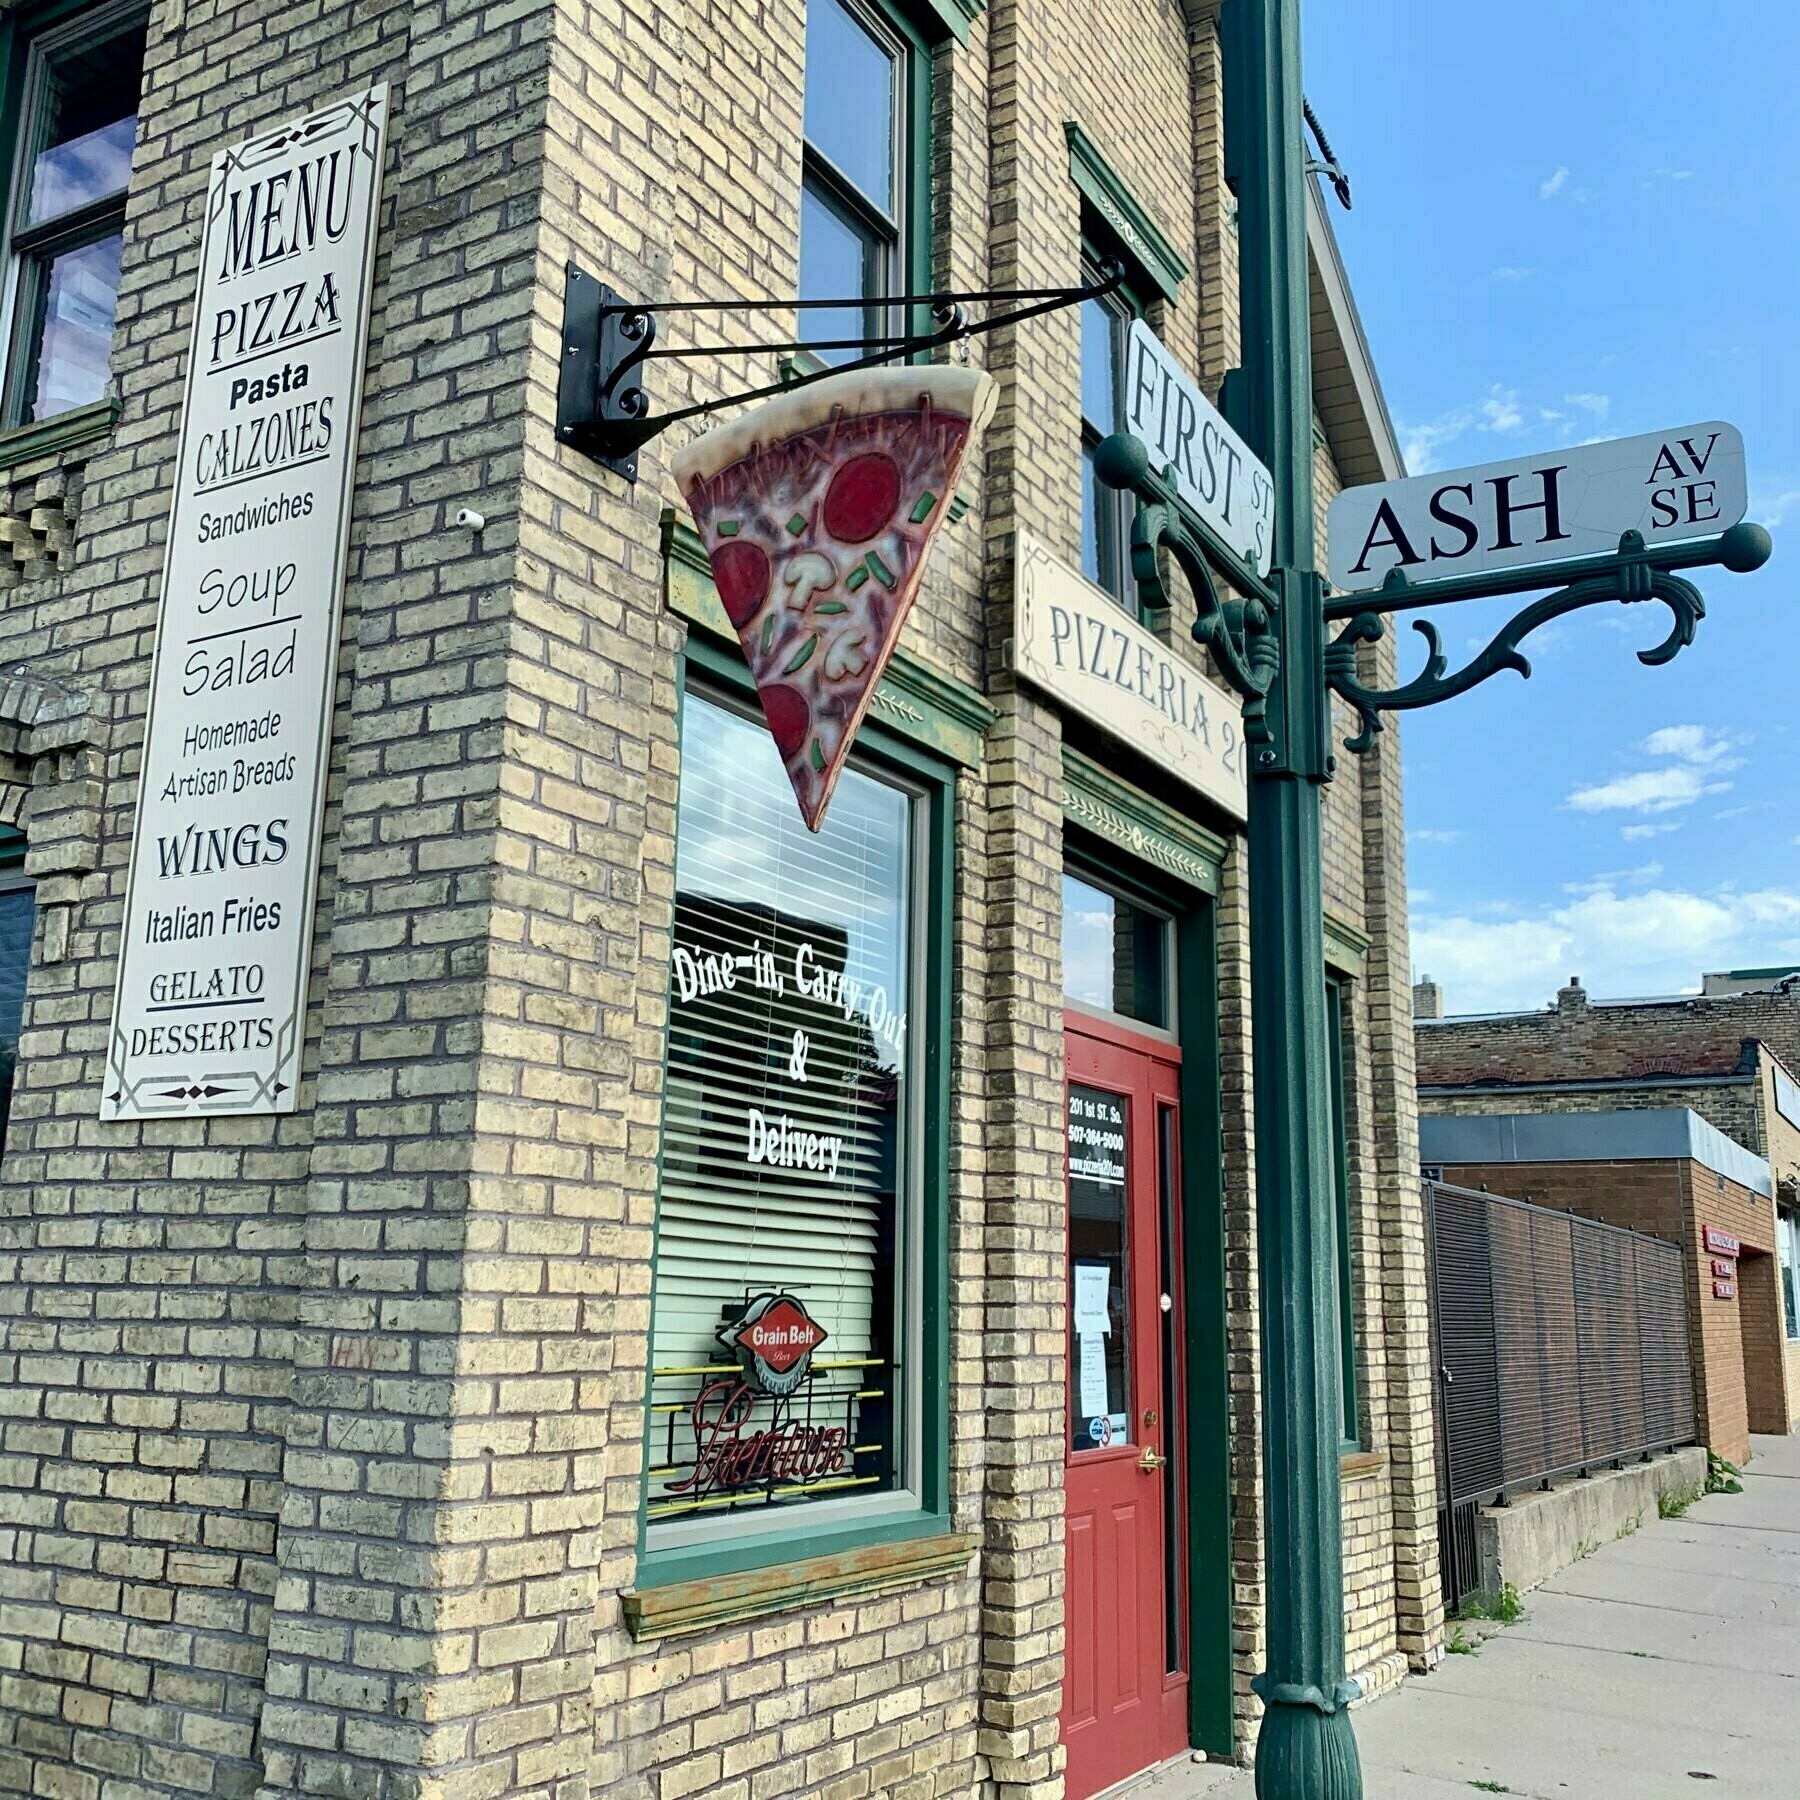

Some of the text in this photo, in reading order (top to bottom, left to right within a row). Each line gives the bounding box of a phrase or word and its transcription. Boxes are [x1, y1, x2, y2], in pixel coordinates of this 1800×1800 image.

[218, 143, 359, 284] MENU
[210, 272, 341, 364] PIZZA
[230, 363, 309, 410] Pasta
[197, 396, 334, 486] CALZONES
[1130, 336, 1242, 527] FIRST
[1645, 433, 1722, 484] AV
[198, 490, 313, 545] Sandwiches
[1251, 470, 1273, 521] ST
[1347, 465, 1571, 574] ASH
[1651, 480, 1721, 529] SE
[1254, 521, 1264, 561] S
[198, 563, 296, 616] Soup
[183, 628, 296, 696] Salad
[1049, 605, 1212, 750] PIZZERIA
[183, 710, 281, 757] Homemade
[161, 753, 296, 802] Artisan Breads
[157, 819, 290, 878] WINGS
[146, 898, 281, 944] Italian Fries
[150, 965, 264, 1003] GELATO
[672, 939, 907, 1050] Dine-in, Carry Out
[130, 1017, 274, 1059] DESSERTS
[789, 1029, 809, 1082] &
[1069, 1097, 1123, 1124] 201 1st ST. So.
[747, 1108, 842, 1181] Delivery
[752, 1325, 815, 1346] Grain Belt
[772, 1351, 791, 1361] Beer
